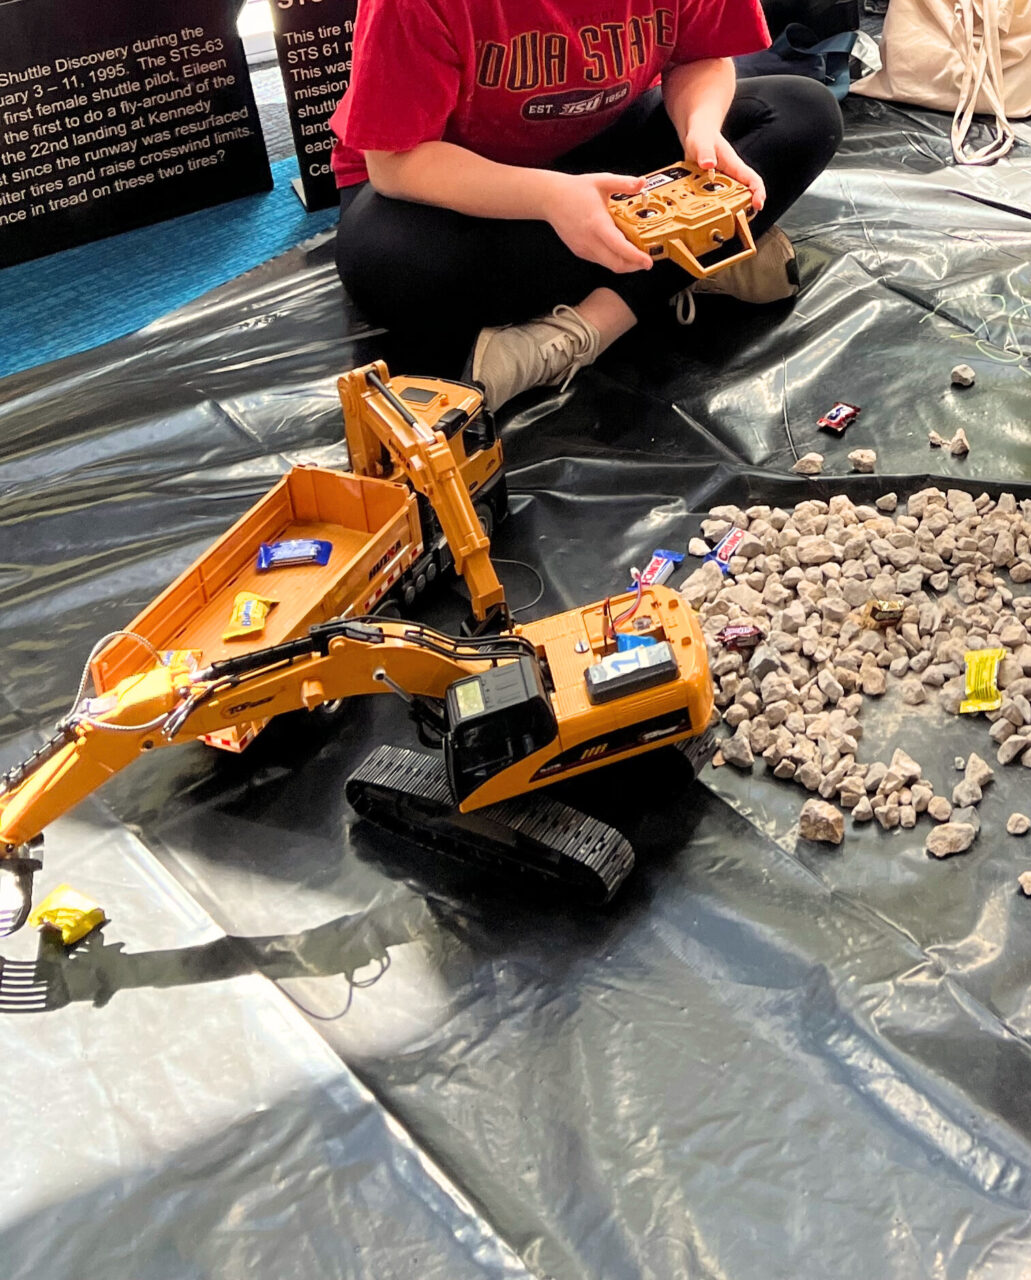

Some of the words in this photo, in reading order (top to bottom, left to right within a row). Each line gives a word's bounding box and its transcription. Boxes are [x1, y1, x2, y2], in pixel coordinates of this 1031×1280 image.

[0, 65, 51, 87] Shuttle
[55, 46, 128, 72] Discovery
[132, 33, 178, 53] during
[181, 26, 204, 41] the
[283, 27, 315, 46] This
[318, 24, 341, 39] tire
[344, 21, 354, 34] fl
[287, 45, 319, 64] STS
[322, 42, 340, 56] 61
[476, 30, 569, 92] OWA
[3, 107, 34, 126] first
[36, 94, 88, 117] female
[92, 80, 141, 103] shuttle
[144, 70, 180, 91] pilot,
[182, 58, 227, 78] Eileen
[32, 84, 44, 98] 3
[62, 75, 85, 90] 11,
[89, 63, 130, 83] 1995.
[137, 55, 167, 71] The
[170, 38, 224, 62] STS-63
[290, 65, 322, 82] This
[325, 60, 353, 75] was
[294, 79, 348, 101] mission
[1, 149, 27, 166] the
[30, 136, 69, 158] 22nd
[72, 124, 127, 146] landing
[130, 116, 146, 130] at
[148, 100, 211, 125] Kennedy
[4, 128, 29, 145] the
[32, 120, 62, 138] first
[65, 116, 80, 128] to
[84, 109, 103, 124] do
[107, 106, 117, 117] a
[120, 84, 192, 115] fly-around
[195, 78, 209, 93] of
[212, 74, 236, 89] the
[12, 162, 53, 183] since
[55, 154, 81, 170] the
[85, 139, 137, 162] runway
[141, 130, 172, 146] was
[175, 105, 249, 137] resurfaced
[30, 180, 64, 198] tires
[67, 168, 96, 187] and
[100, 159, 136, 177] raise
[140, 135, 211, 166] crosswind
[214, 126, 255, 145] limits.
[304, 137, 338, 154] each
[31, 203, 45, 217] in
[49, 189, 88, 211] tread
[92, 185, 111, 198] on
[114, 172, 155, 193] these
[157, 163, 184, 180] two
[187, 150, 226, 171] tires?
[717, 529, 745, 561] CRUNC
